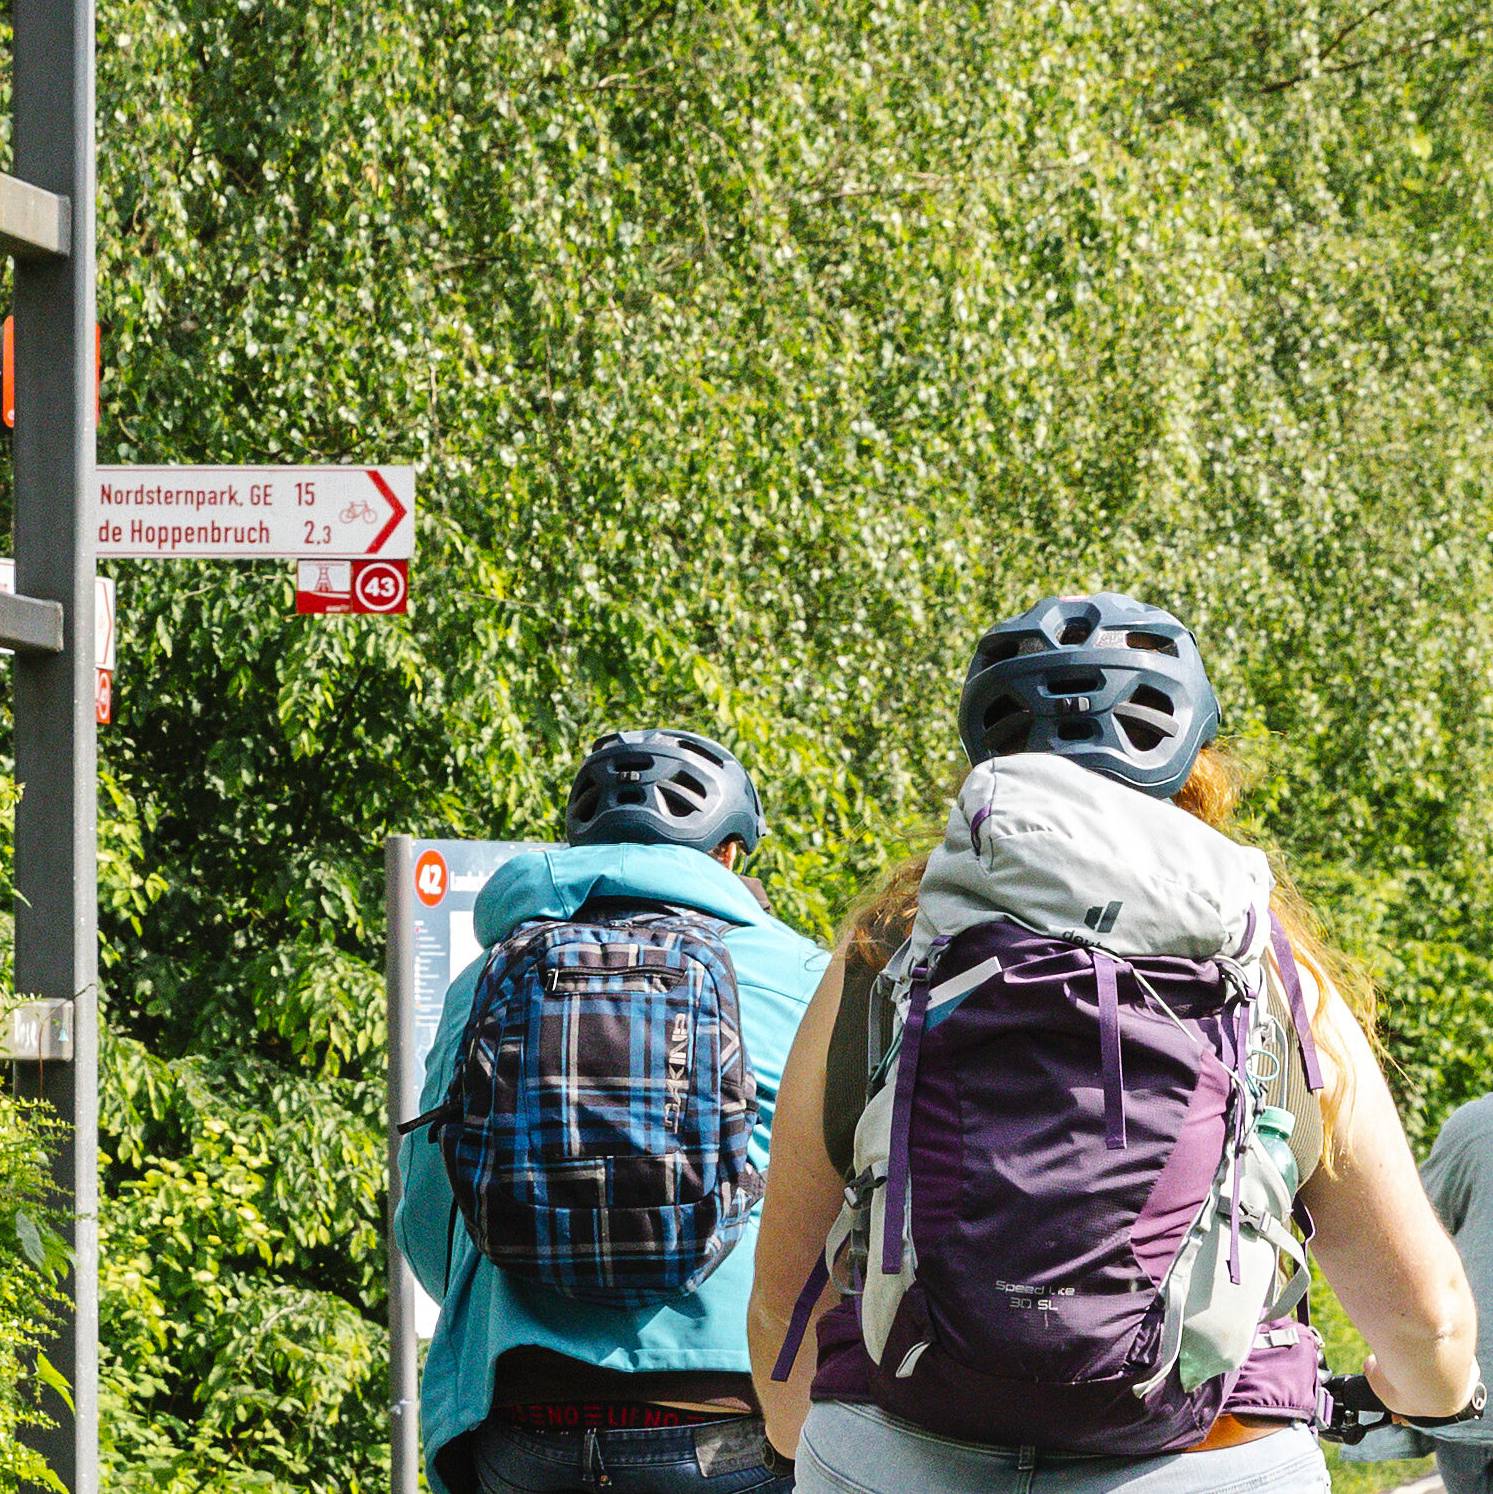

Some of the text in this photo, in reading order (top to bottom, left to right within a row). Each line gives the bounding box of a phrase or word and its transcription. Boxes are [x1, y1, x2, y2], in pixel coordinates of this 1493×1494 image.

[99, 482, 316, 511] Nordsternpark, GE 15
[130, 518, 271, 550] Hoppenbruch
[303, 520, 332, 546] 2,3
[364, 576, 396, 598] 43
[418, 863, 442, 896] 42
[994, 1279, 1045, 1295] Speed
[1009, 1296, 1059, 1311] 30 SL
